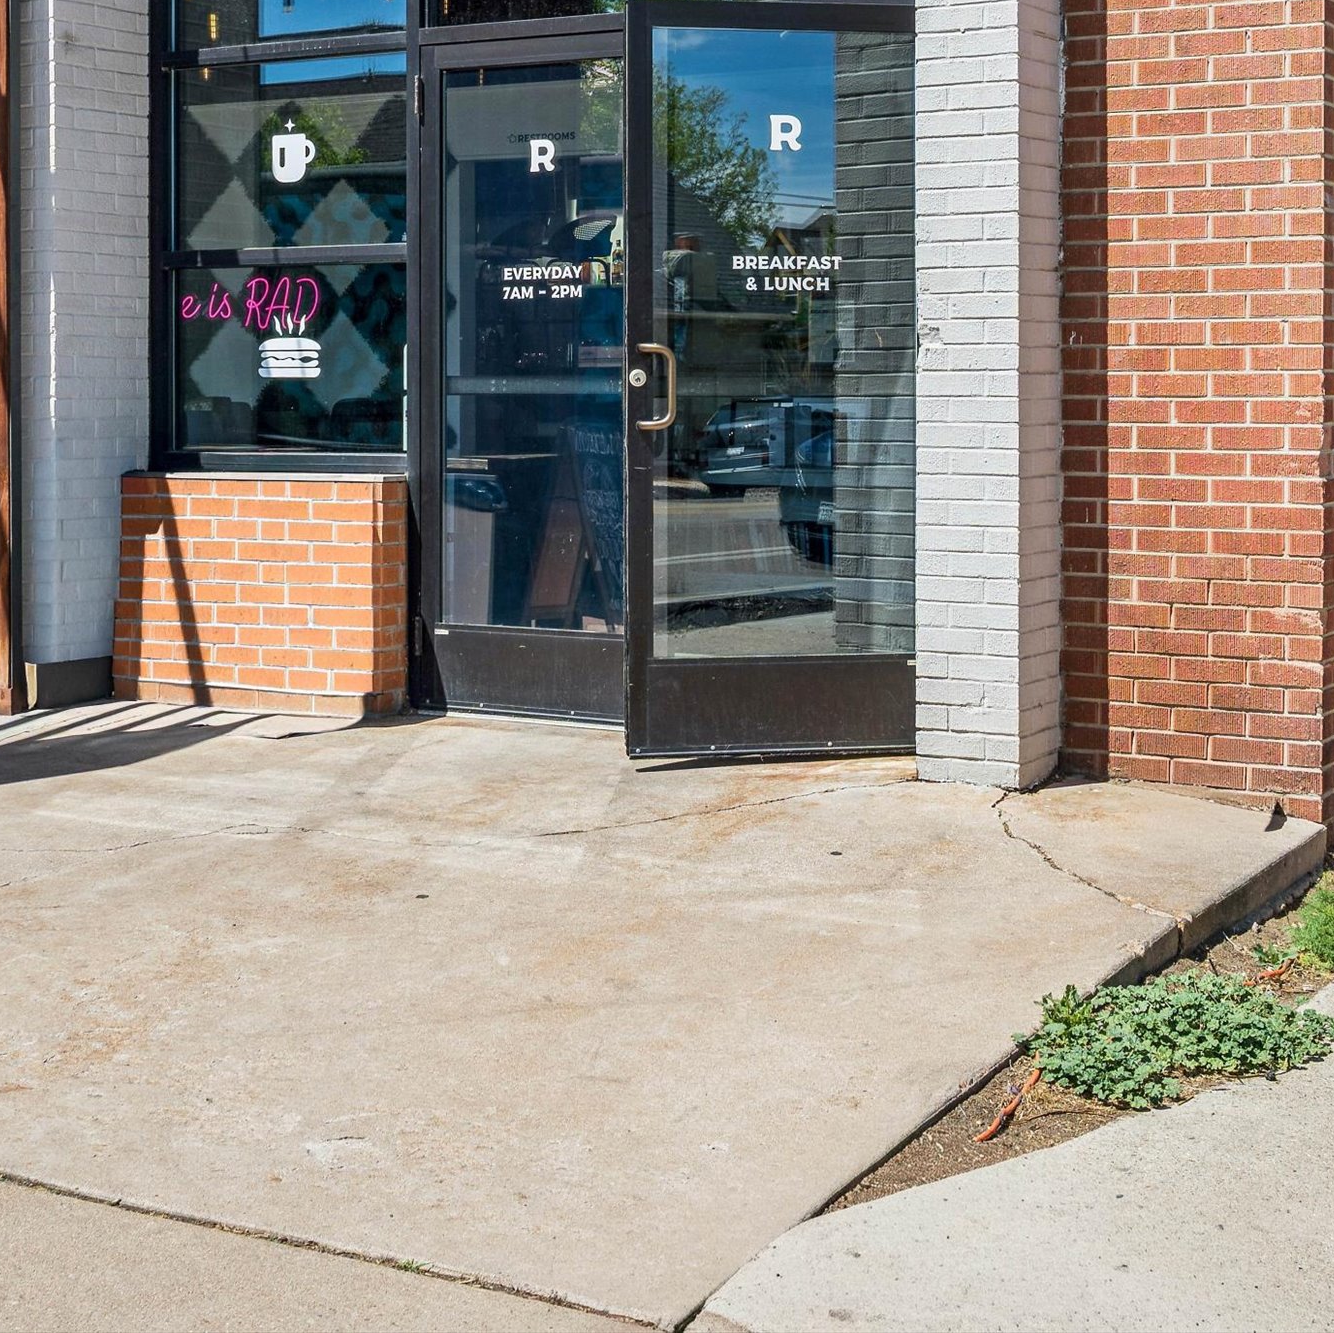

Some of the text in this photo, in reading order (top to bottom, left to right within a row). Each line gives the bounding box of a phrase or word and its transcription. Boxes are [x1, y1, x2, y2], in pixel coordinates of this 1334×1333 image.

[518, 131, 576, 143] RESTROOMS
[769, 114, 802, 151] R
[530, 139, 556, 173] R
[732, 255, 842, 270] BREAKFAST
[503, 266, 583, 281] EVERYDAY
[745, 277, 830, 291] & LUNCH
[502, 285, 534, 300] 7AM
[551, 285, 583, 299] 2PM
[208, 282, 232, 319] is
[244, 276, 320, 330] RAD
